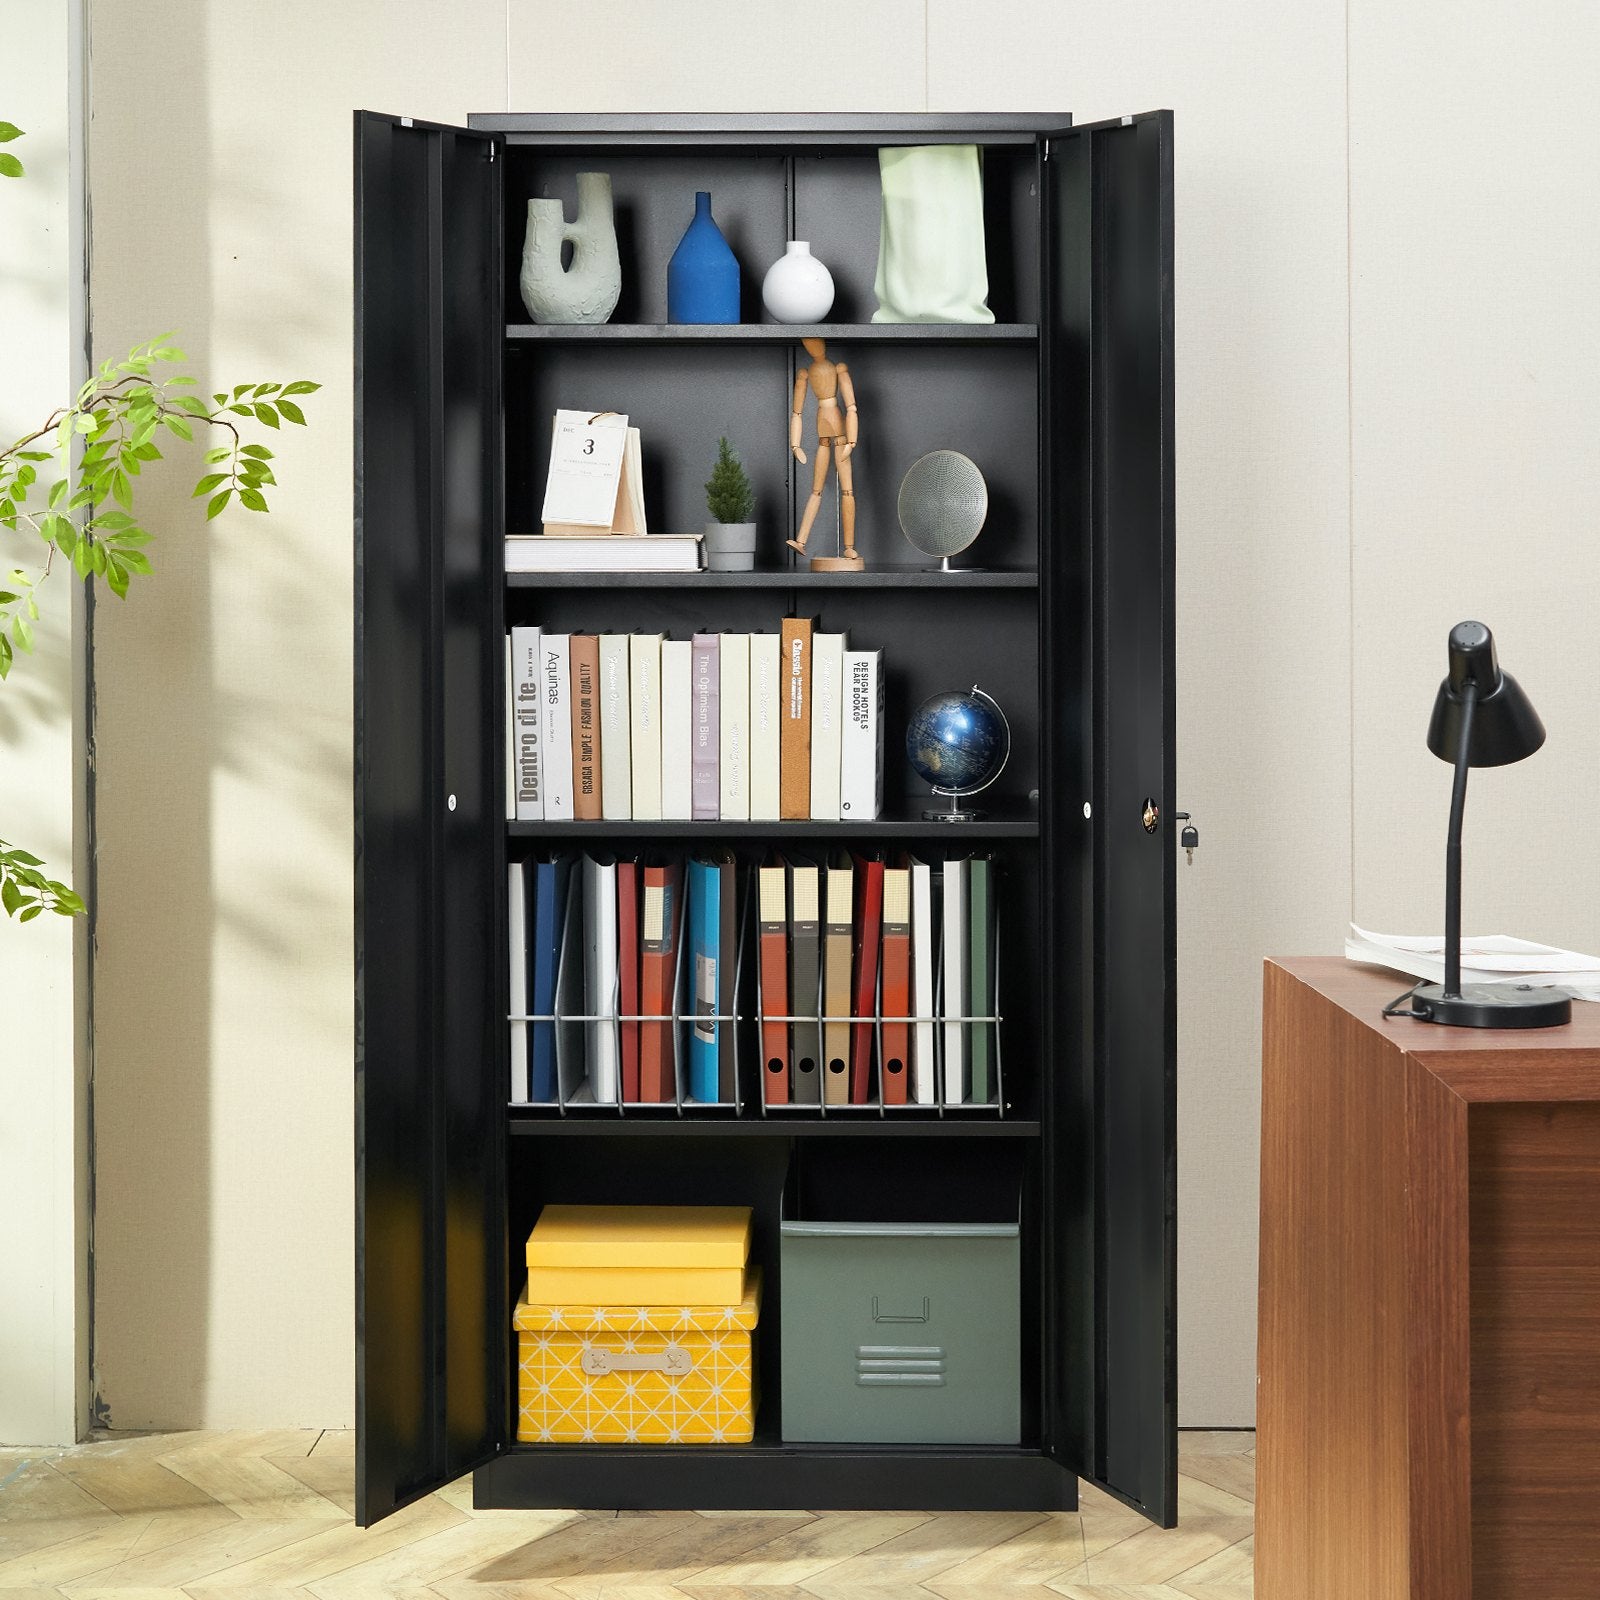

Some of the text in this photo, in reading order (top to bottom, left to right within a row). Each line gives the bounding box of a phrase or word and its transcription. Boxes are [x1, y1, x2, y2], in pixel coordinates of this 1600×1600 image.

[583, 438, 595, 455] 3
[545, 651, 561, 705] Aquinas
[580, 663, 592, 694] QUALITY
[853, 661, 861, 684] YEAR
[698, 655, 710, 747] The Optimism Bias
[860, 661, 869, 730] DESIGN HOTELS
[580, 697, 592, 730] FASHION
[518, 682, 538, 802] Dentro di te
[581, 734, 593, 762] SIMPLE
